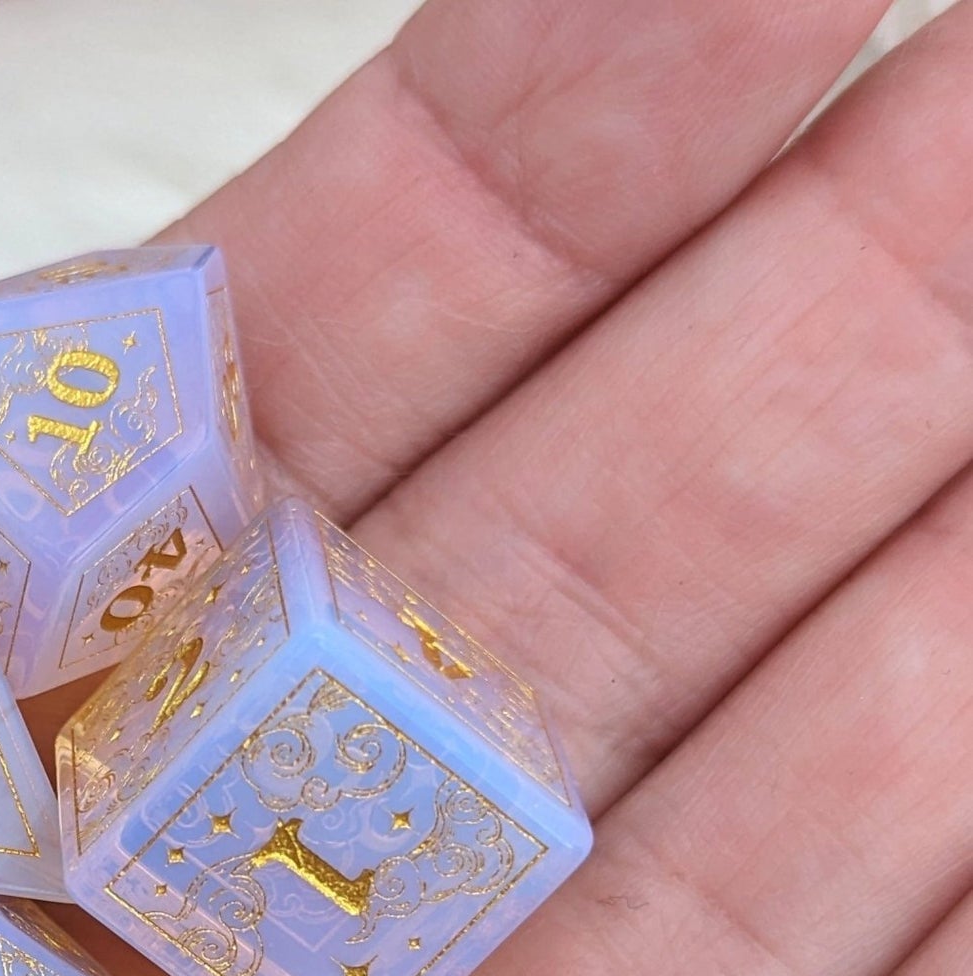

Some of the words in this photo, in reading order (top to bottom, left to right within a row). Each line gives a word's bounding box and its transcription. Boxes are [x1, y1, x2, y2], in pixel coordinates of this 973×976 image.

[28, 349, 120, 456] 10
[100, 528, 188, 633] 40
[252, 818, 375, 916] 1
